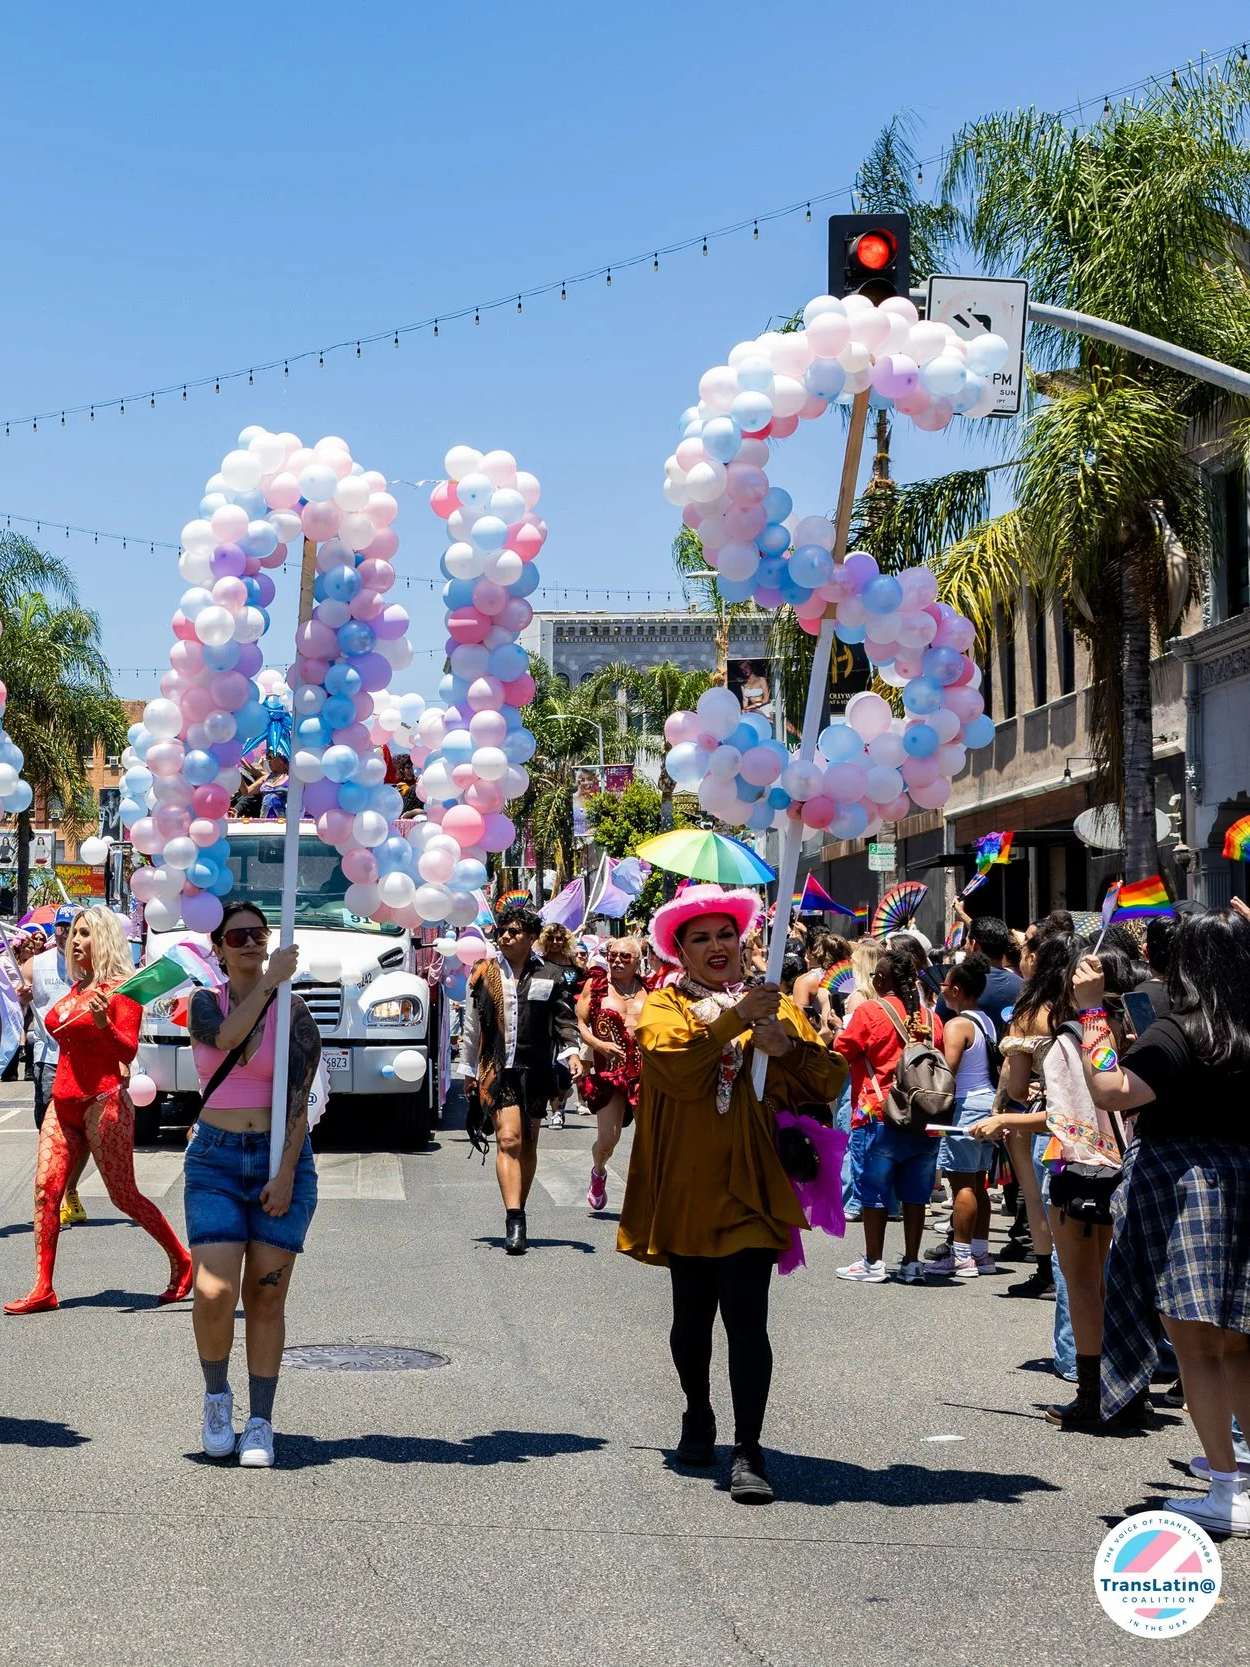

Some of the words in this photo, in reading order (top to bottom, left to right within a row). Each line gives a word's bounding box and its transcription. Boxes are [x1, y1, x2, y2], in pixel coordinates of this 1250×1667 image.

[992, 373, 1012, 386] PM
[350, 914, 372, 924] 91
[322, 1057, 347, 1068] 68Z3
